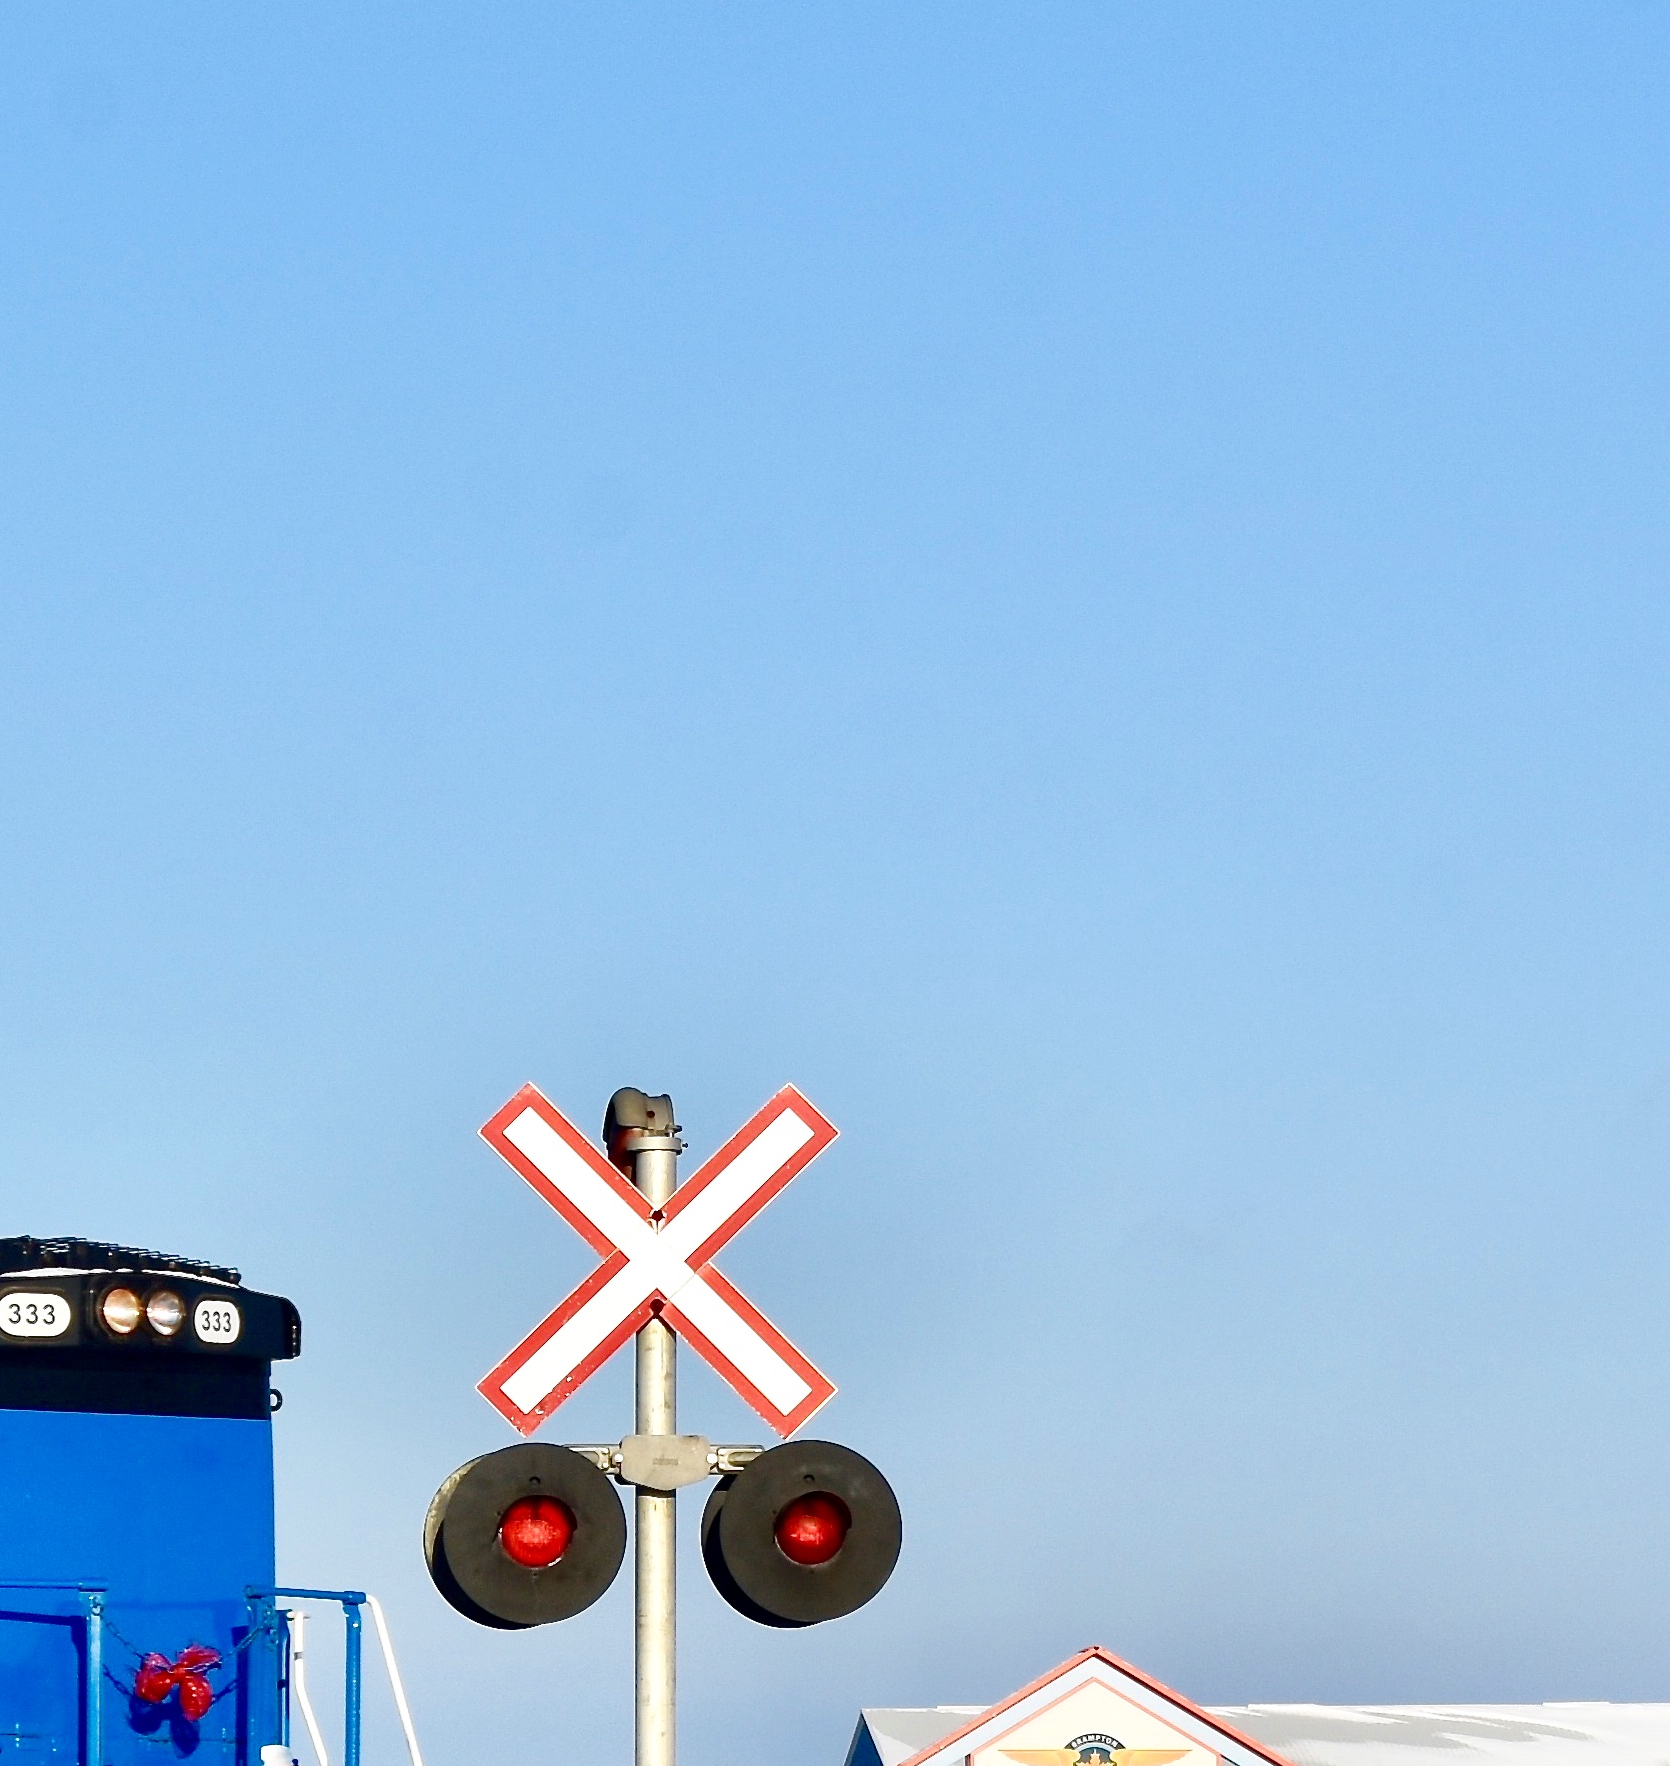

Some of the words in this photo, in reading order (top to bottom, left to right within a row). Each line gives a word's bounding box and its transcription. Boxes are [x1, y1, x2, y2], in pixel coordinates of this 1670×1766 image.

[8, 1303, 56, 1325] 333
[201, 1310, 231, 1333] 333
[1071, 1734, 1119, 1748] BRAMPTON
